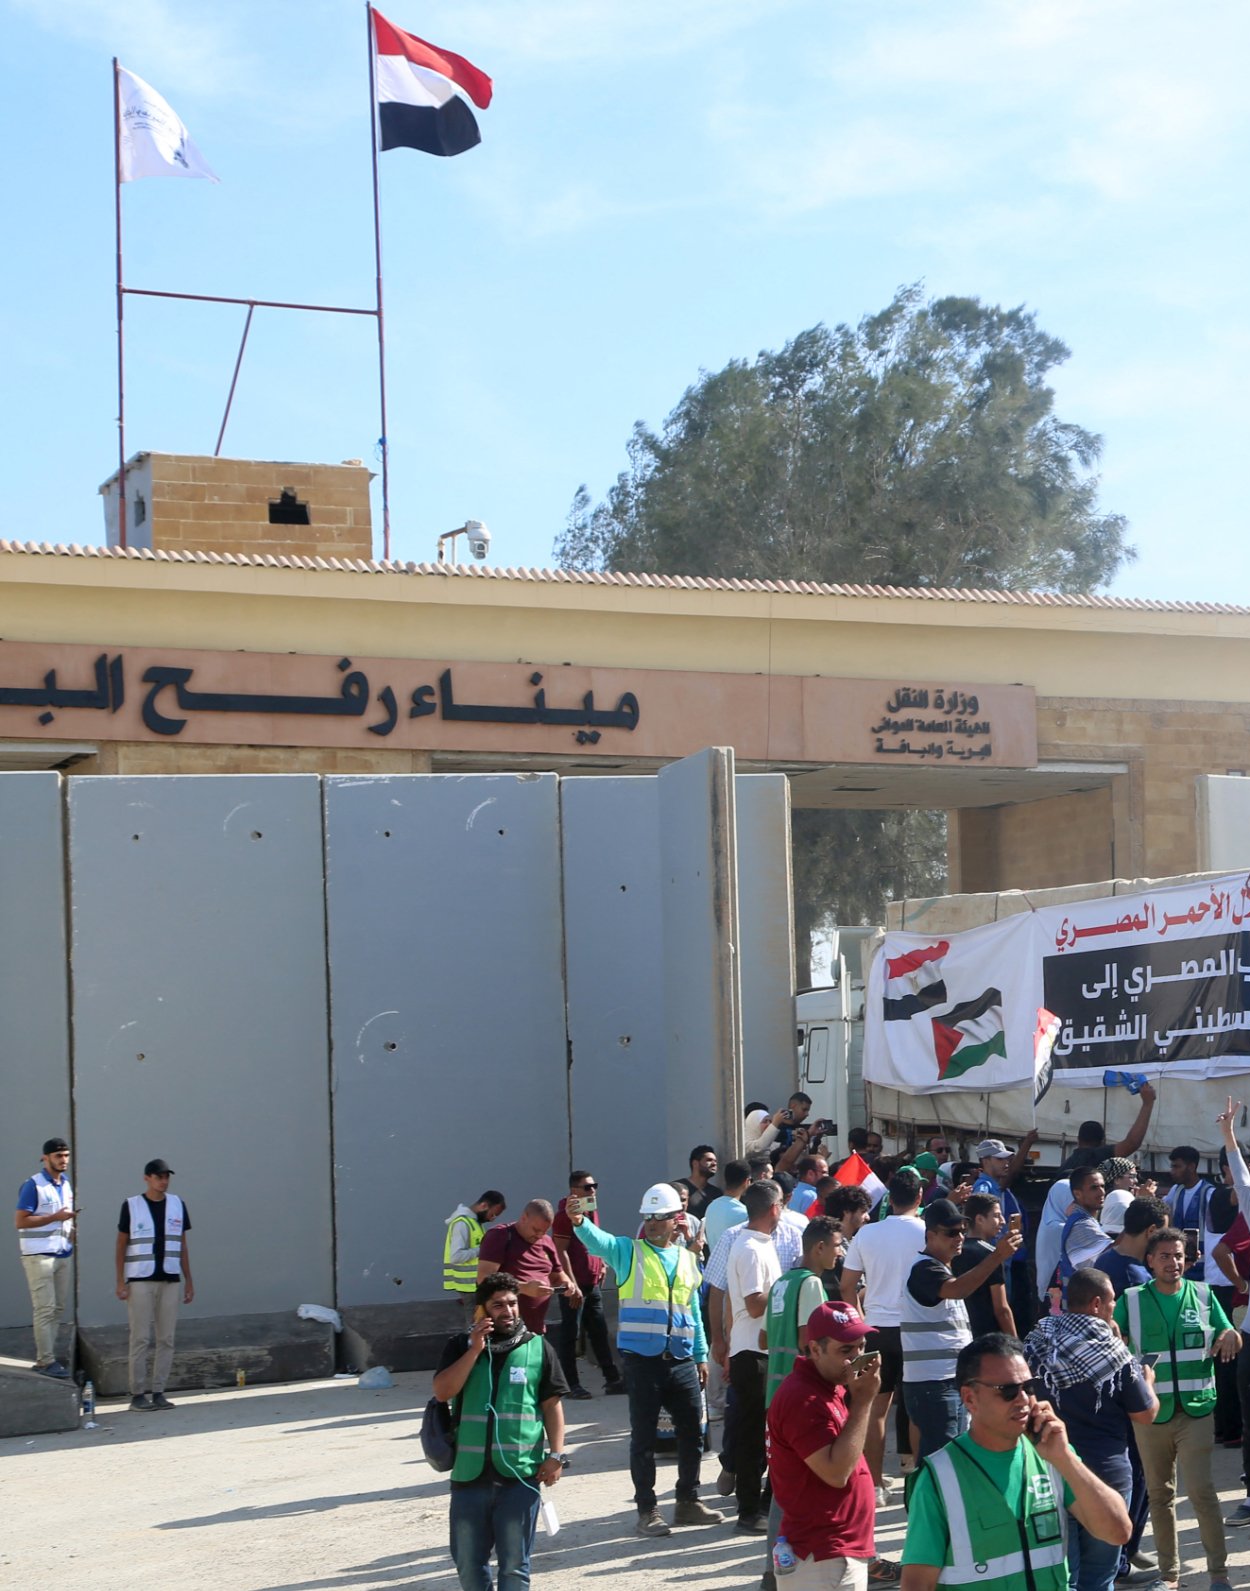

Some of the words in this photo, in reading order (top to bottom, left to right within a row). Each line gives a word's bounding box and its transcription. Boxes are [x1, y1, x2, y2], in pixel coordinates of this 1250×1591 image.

[0, 652, 125, 726] الب
[141, 656, 398, 736] رفح
[409, 667, 640, 745] ميناء
[886, 686, 929, 713] النقل
[933, 688, 979, 715] وزارة
[914, 719, 952, 733] العامة
[954, 718, 990, 738] الهيئة
[1055, 901, 1156, 952] المصري
[1157, 884, 1231, 936] الأحمر
[1082, 962, 1119, 999] إلى
[1123, 949, 1235, 1002] المصري
[1053, 1009, 1148, 1056] الشقيق
